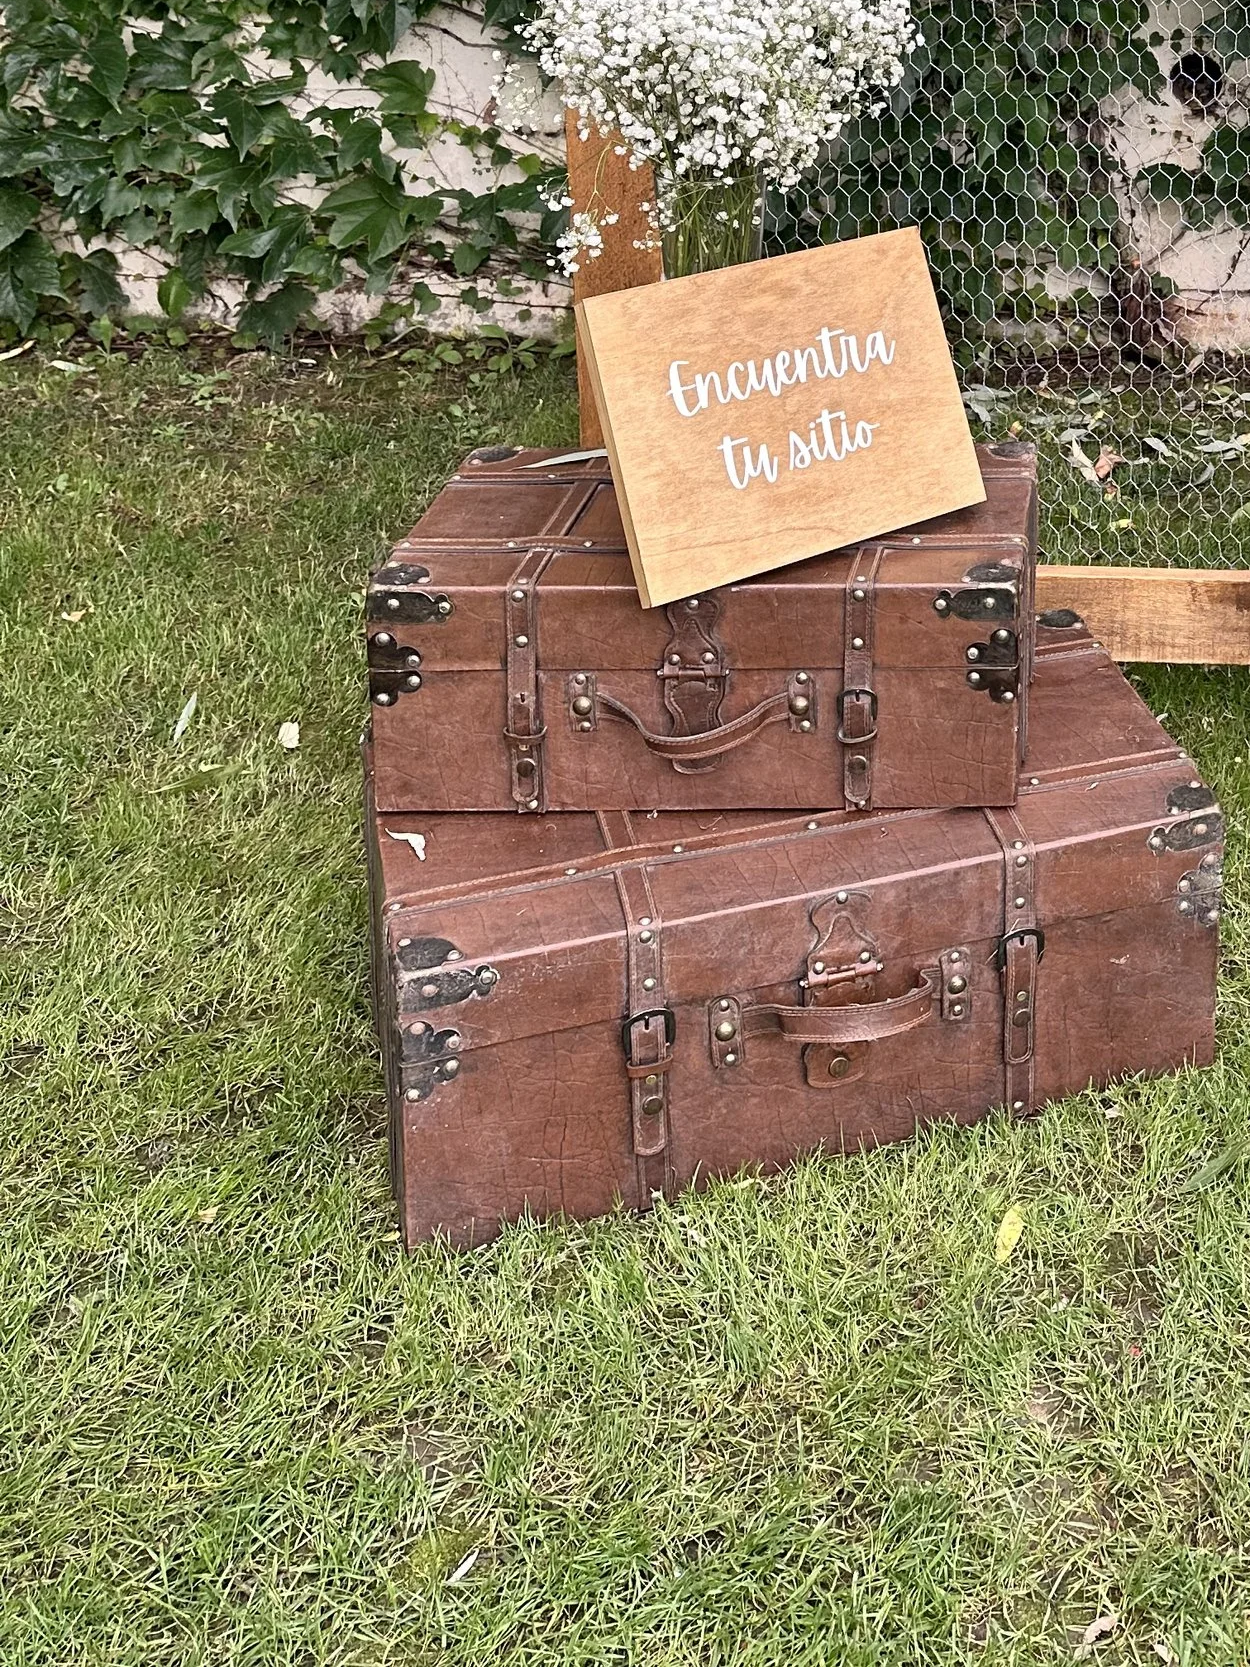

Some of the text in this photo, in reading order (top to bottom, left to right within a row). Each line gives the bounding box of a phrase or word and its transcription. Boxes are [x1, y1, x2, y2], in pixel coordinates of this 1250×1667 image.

[665, 326, 896, 418] Encuentra
[717, 408, 881, 491] tu sitio
